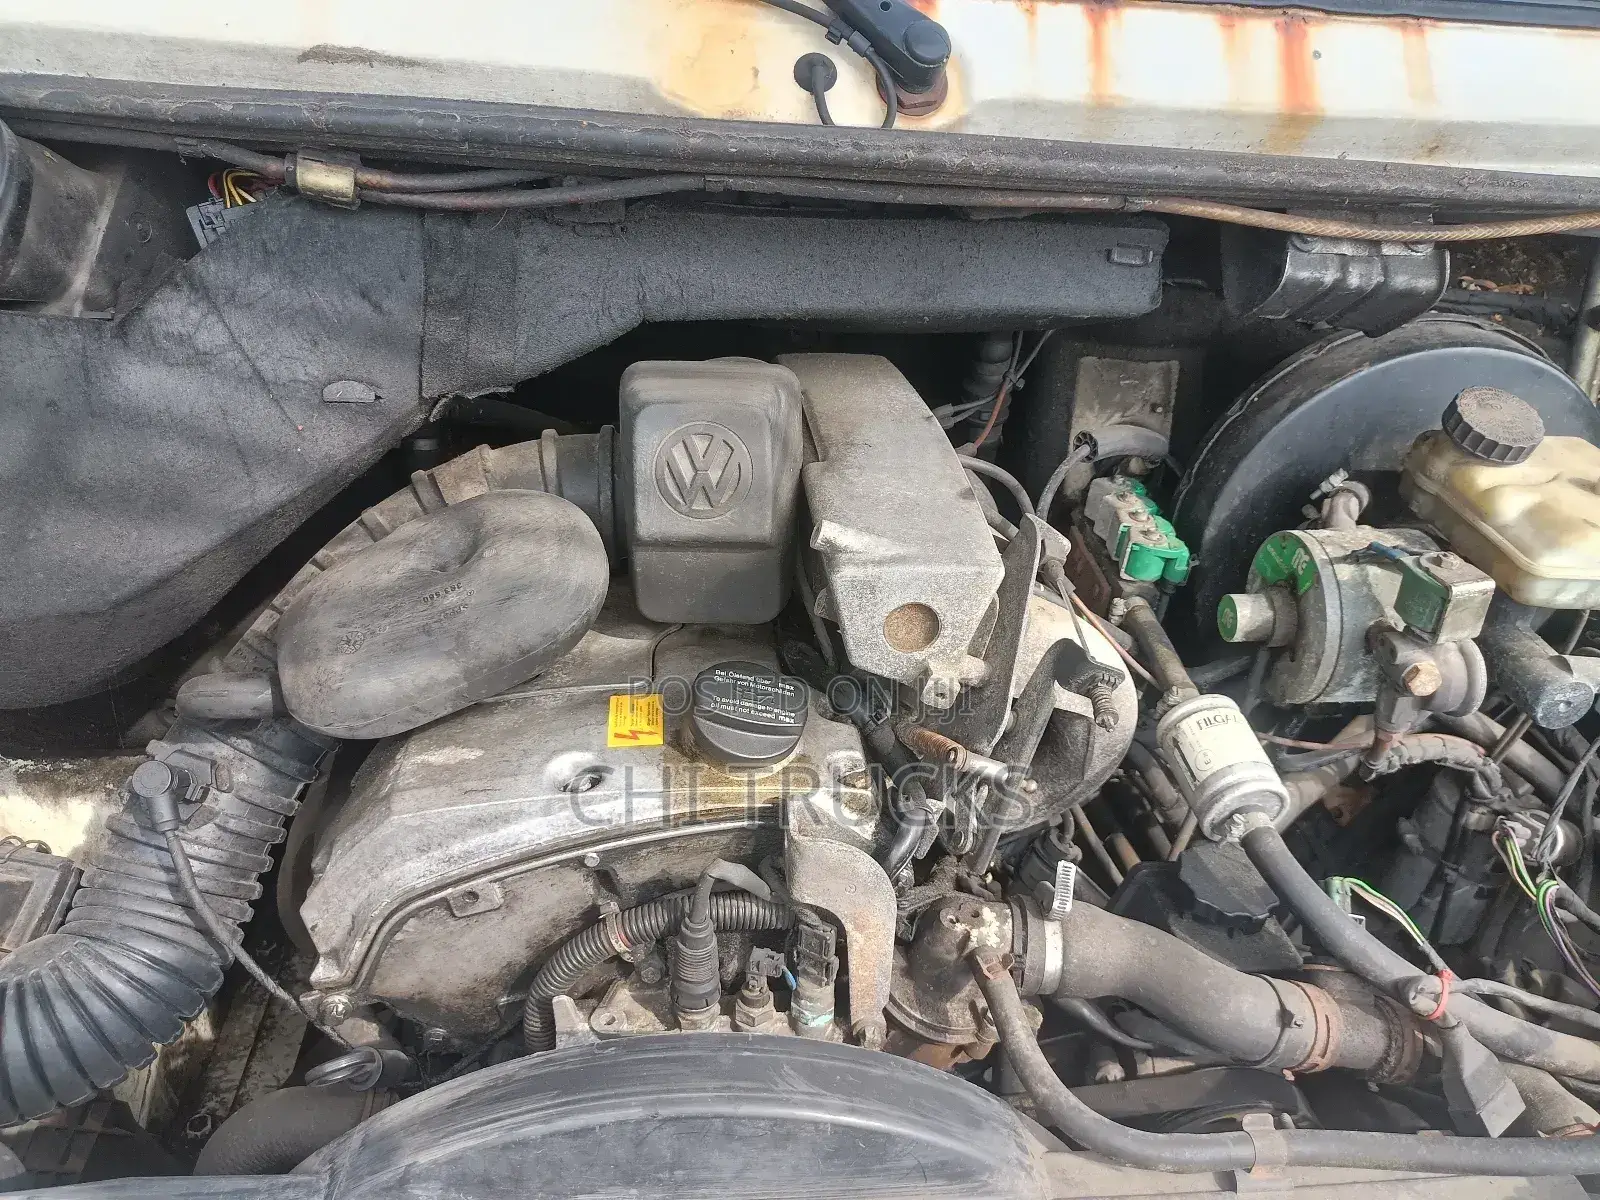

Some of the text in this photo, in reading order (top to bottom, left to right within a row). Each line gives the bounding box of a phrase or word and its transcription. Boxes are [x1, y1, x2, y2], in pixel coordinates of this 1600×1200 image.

[713, 675, 737, 685] Gefahr
[778, 682, 795, 691] max
[721, 697, 740, 705] avoid
[740, 699, 766, 711] damage
[774, 707, 796, 717] engine
[721, 704, 738, 712] must
[738, 706, 750, 714] not
[751, 709, 776, 720] exceed
[778, 715, 795, 724] max
